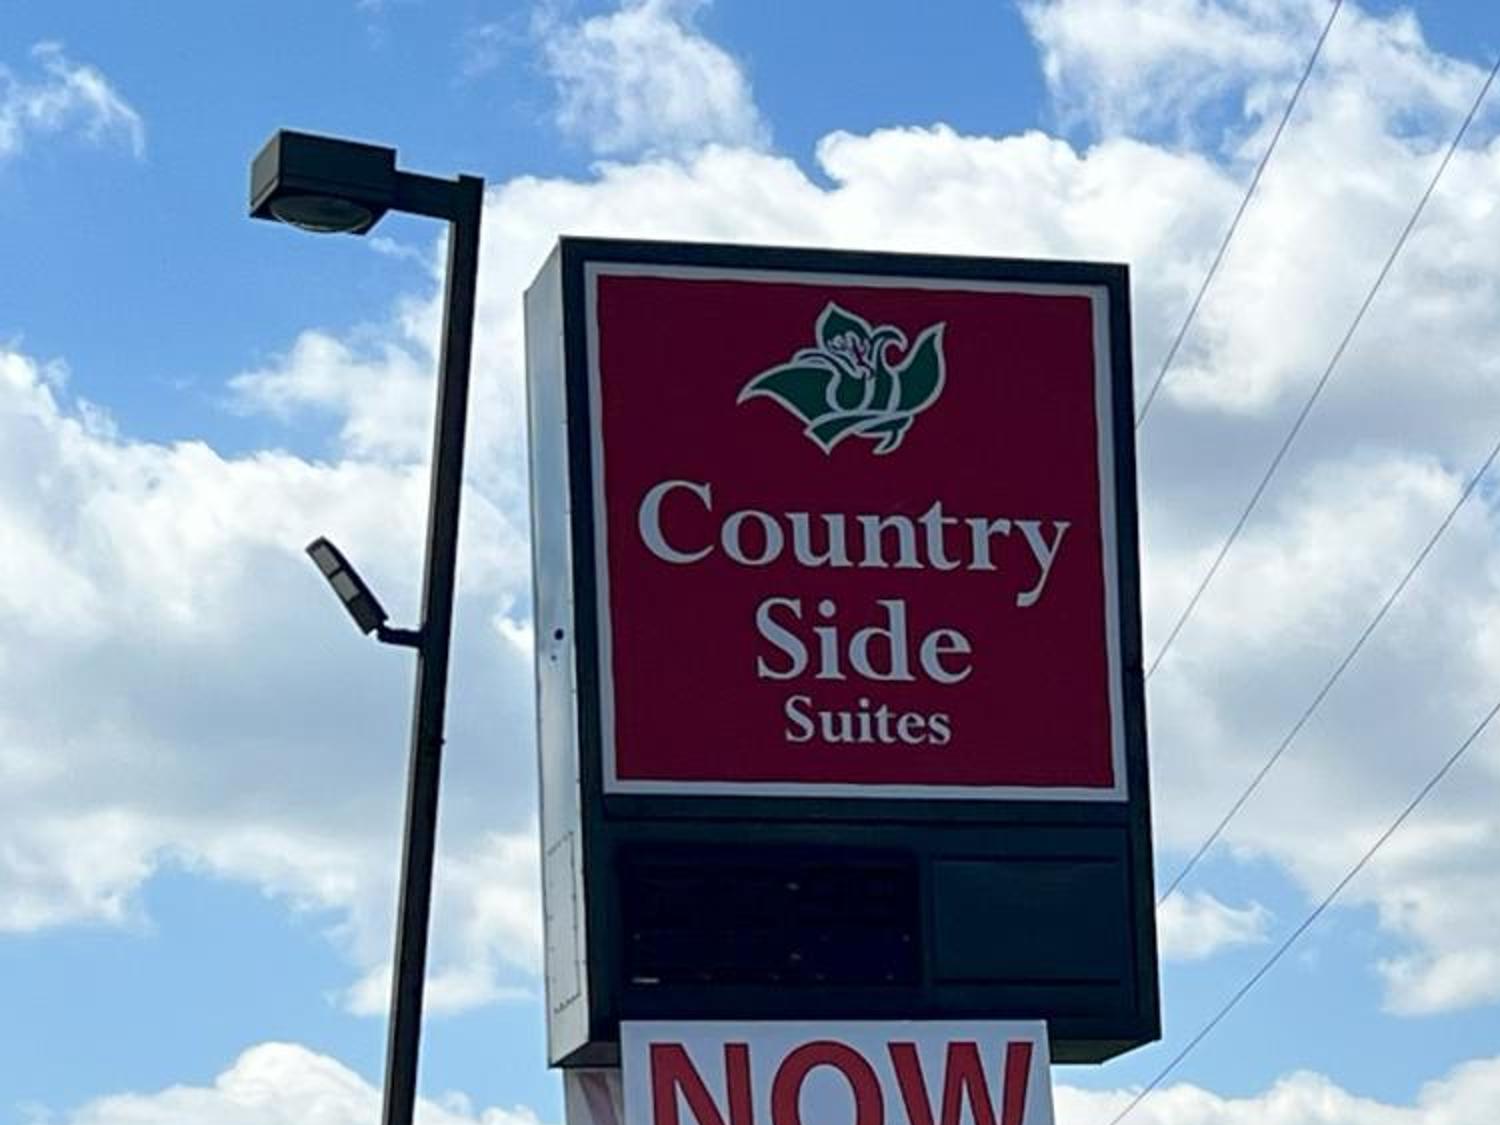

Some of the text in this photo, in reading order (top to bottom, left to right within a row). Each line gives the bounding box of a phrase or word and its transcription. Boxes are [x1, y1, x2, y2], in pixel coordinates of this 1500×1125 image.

[637, 479, 1071, 607] Country
[755, 597, 973, 684] Side
[784, 695, 952, 745] Suites
